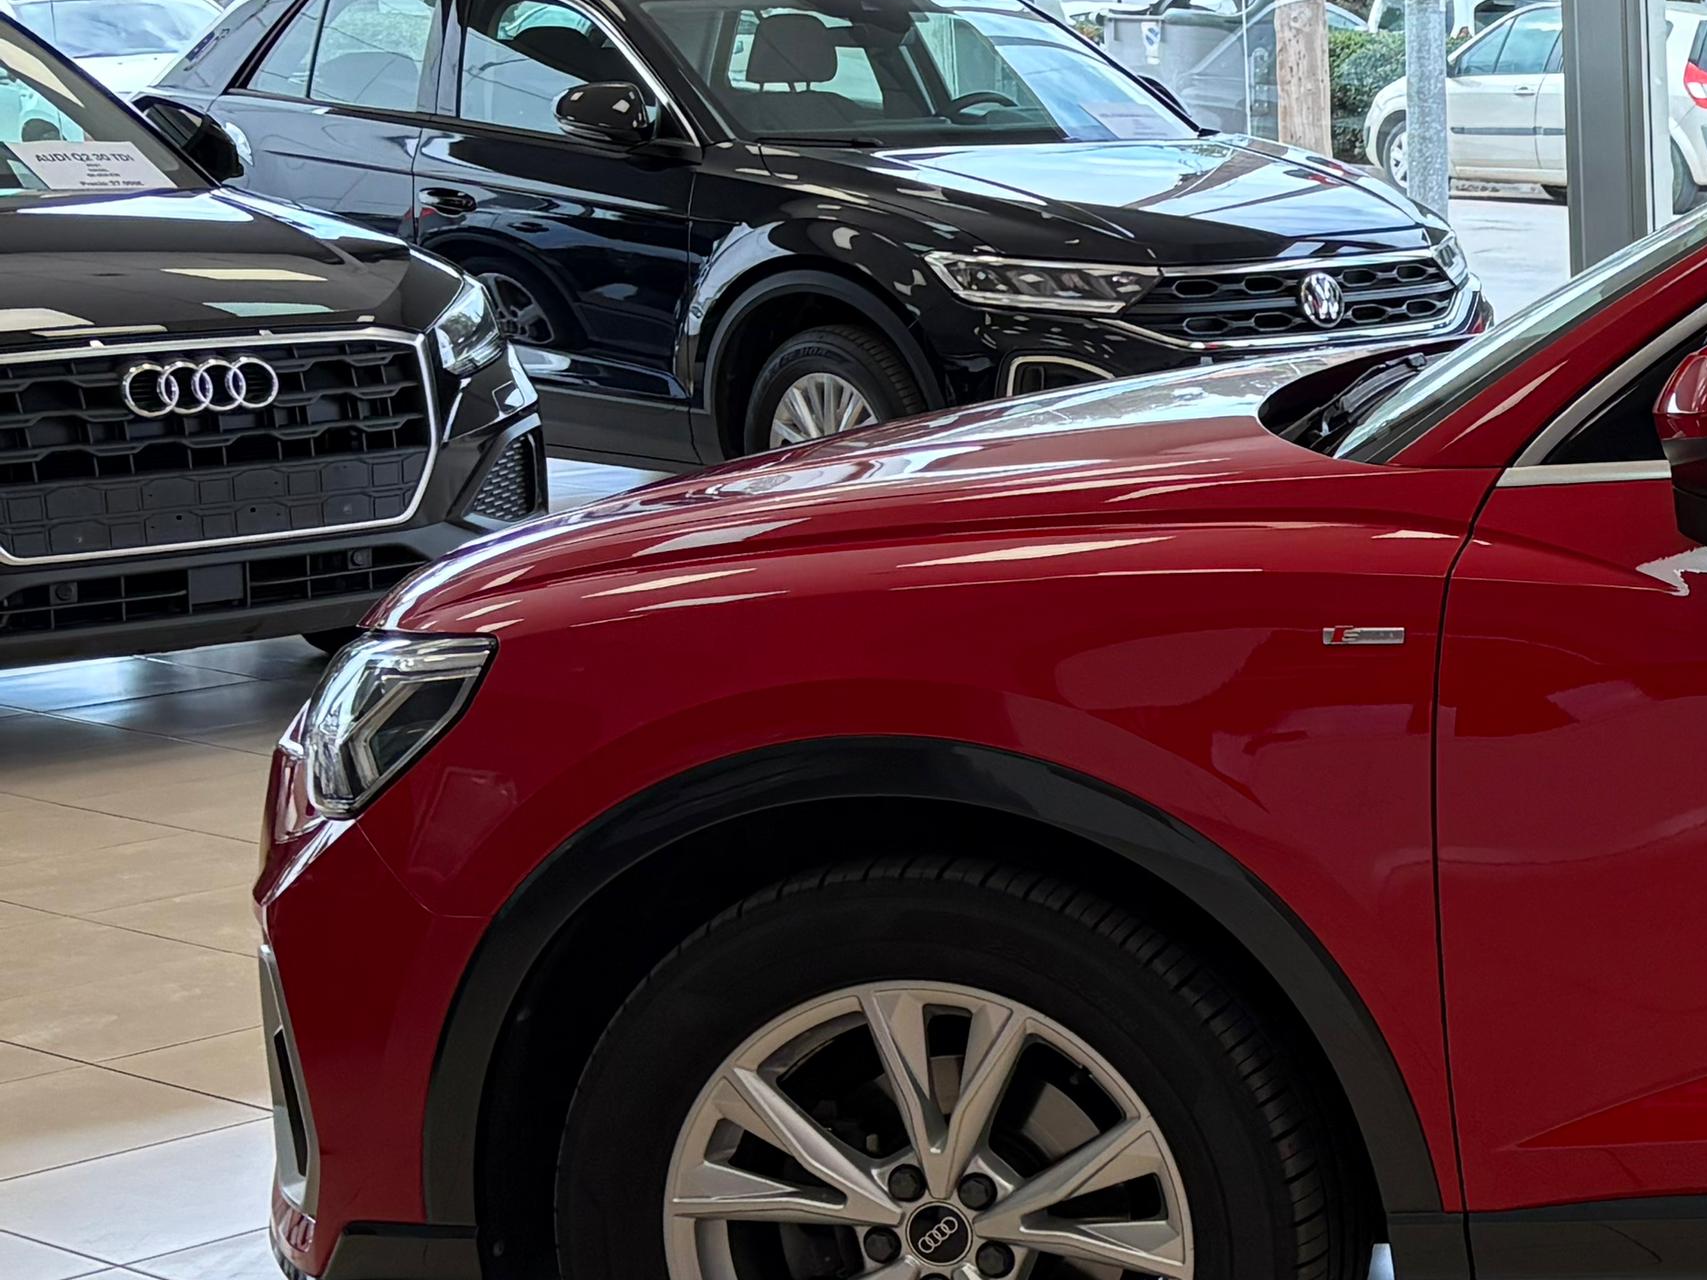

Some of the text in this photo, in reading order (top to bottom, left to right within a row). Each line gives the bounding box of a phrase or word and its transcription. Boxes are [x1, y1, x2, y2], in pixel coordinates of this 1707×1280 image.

[35, 153, 71, 162] AUDI
[72, 153, 90, 162] Q2
[112, 153, 135, 162] TDI
